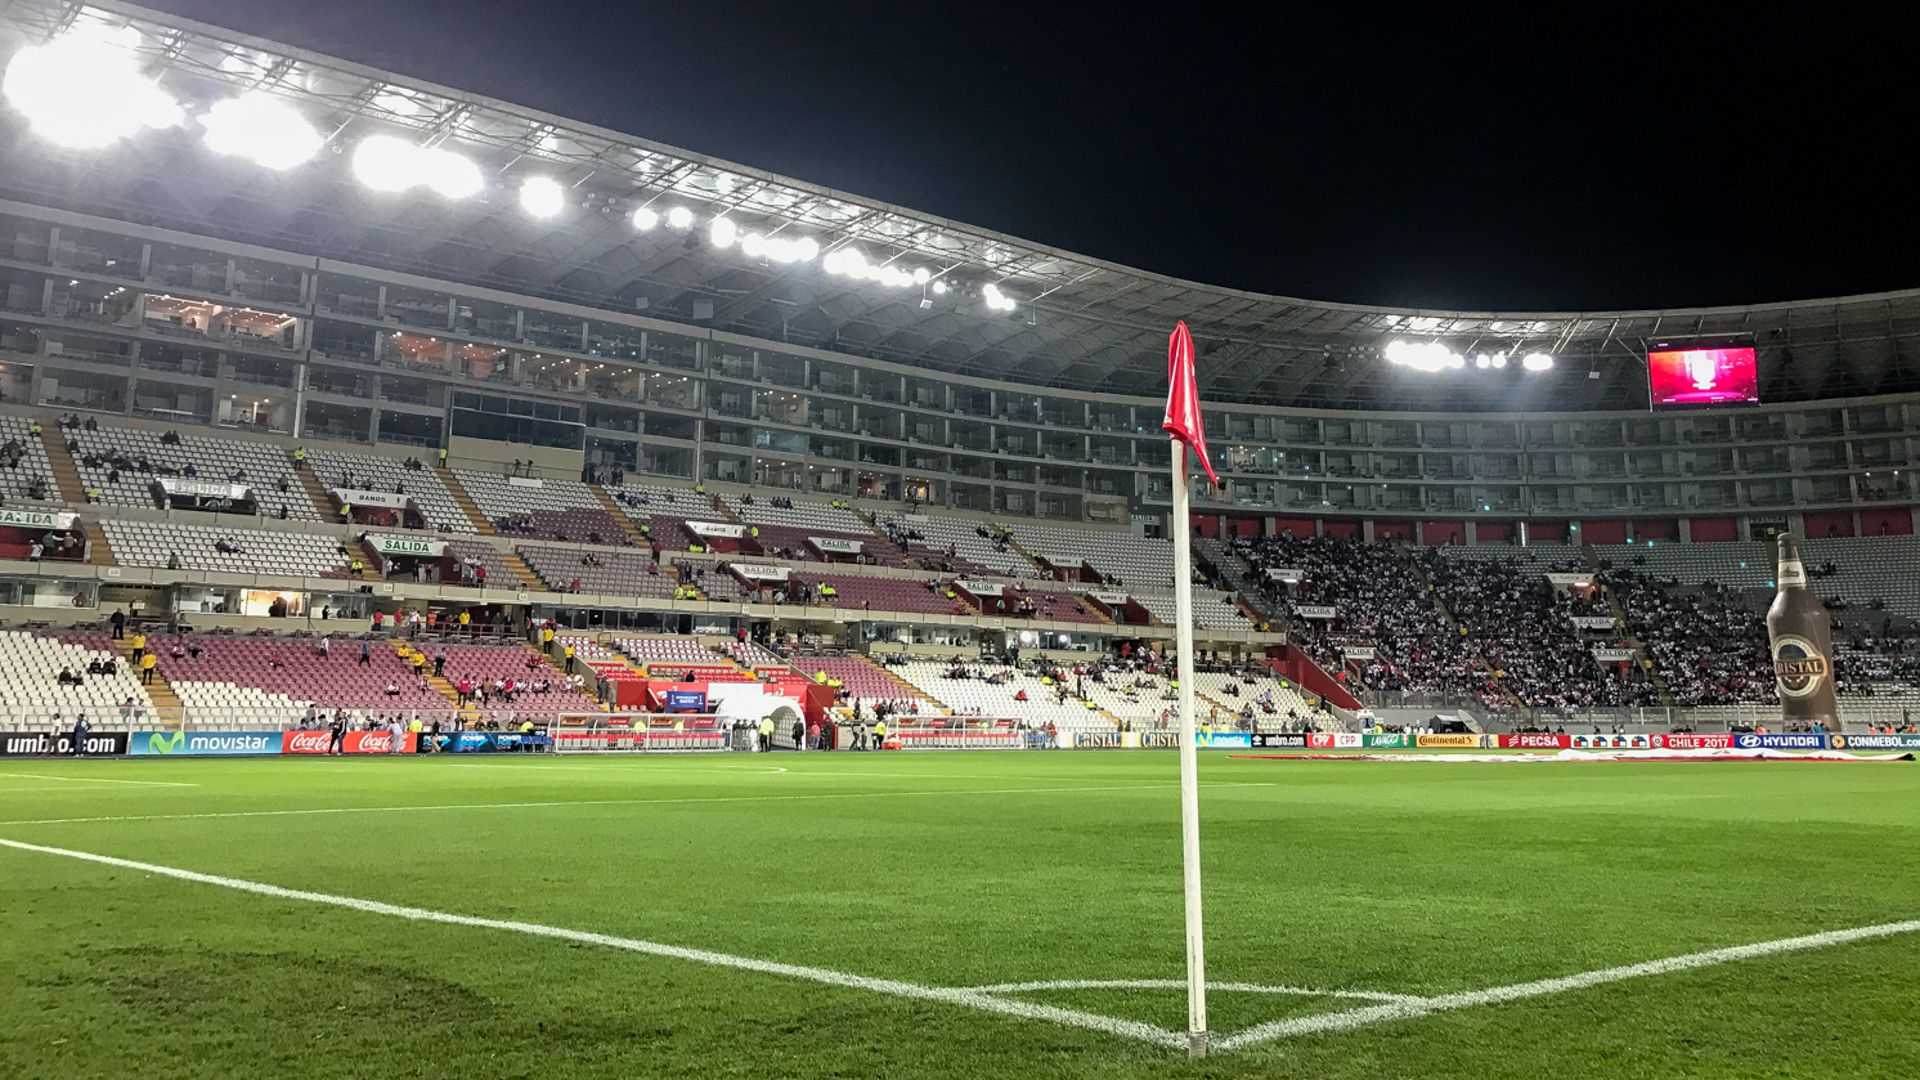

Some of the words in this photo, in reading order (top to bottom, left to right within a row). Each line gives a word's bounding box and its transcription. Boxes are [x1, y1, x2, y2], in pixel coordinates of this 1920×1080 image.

[385, 540, 430, 552] SALIDA
[743, 566, 779, 576] SALIDA
[1775, 660, 1823, 674] RISTAL
[6, 734, 117, 754] umbo.om
[190, 735, 270, 750] movistar
[1075, 733, 1122, 748] CRISTAL
[1142, 733, 1181, 748] CRISTA
[1265, 735, 1304, 746] umbro.com
[1312, 735, 1329, 746] CPP
[1340, 735, 1356, 745] CPP
[1420, 736, 1466, 746] Continental
[1521, 736, 1560, 747] PECSA
[1669, 738, 1700, 748] CHILE
[1704, 738, 1729, 748] 2017
[1763, 736, 1819, 747] HYUNDAI
